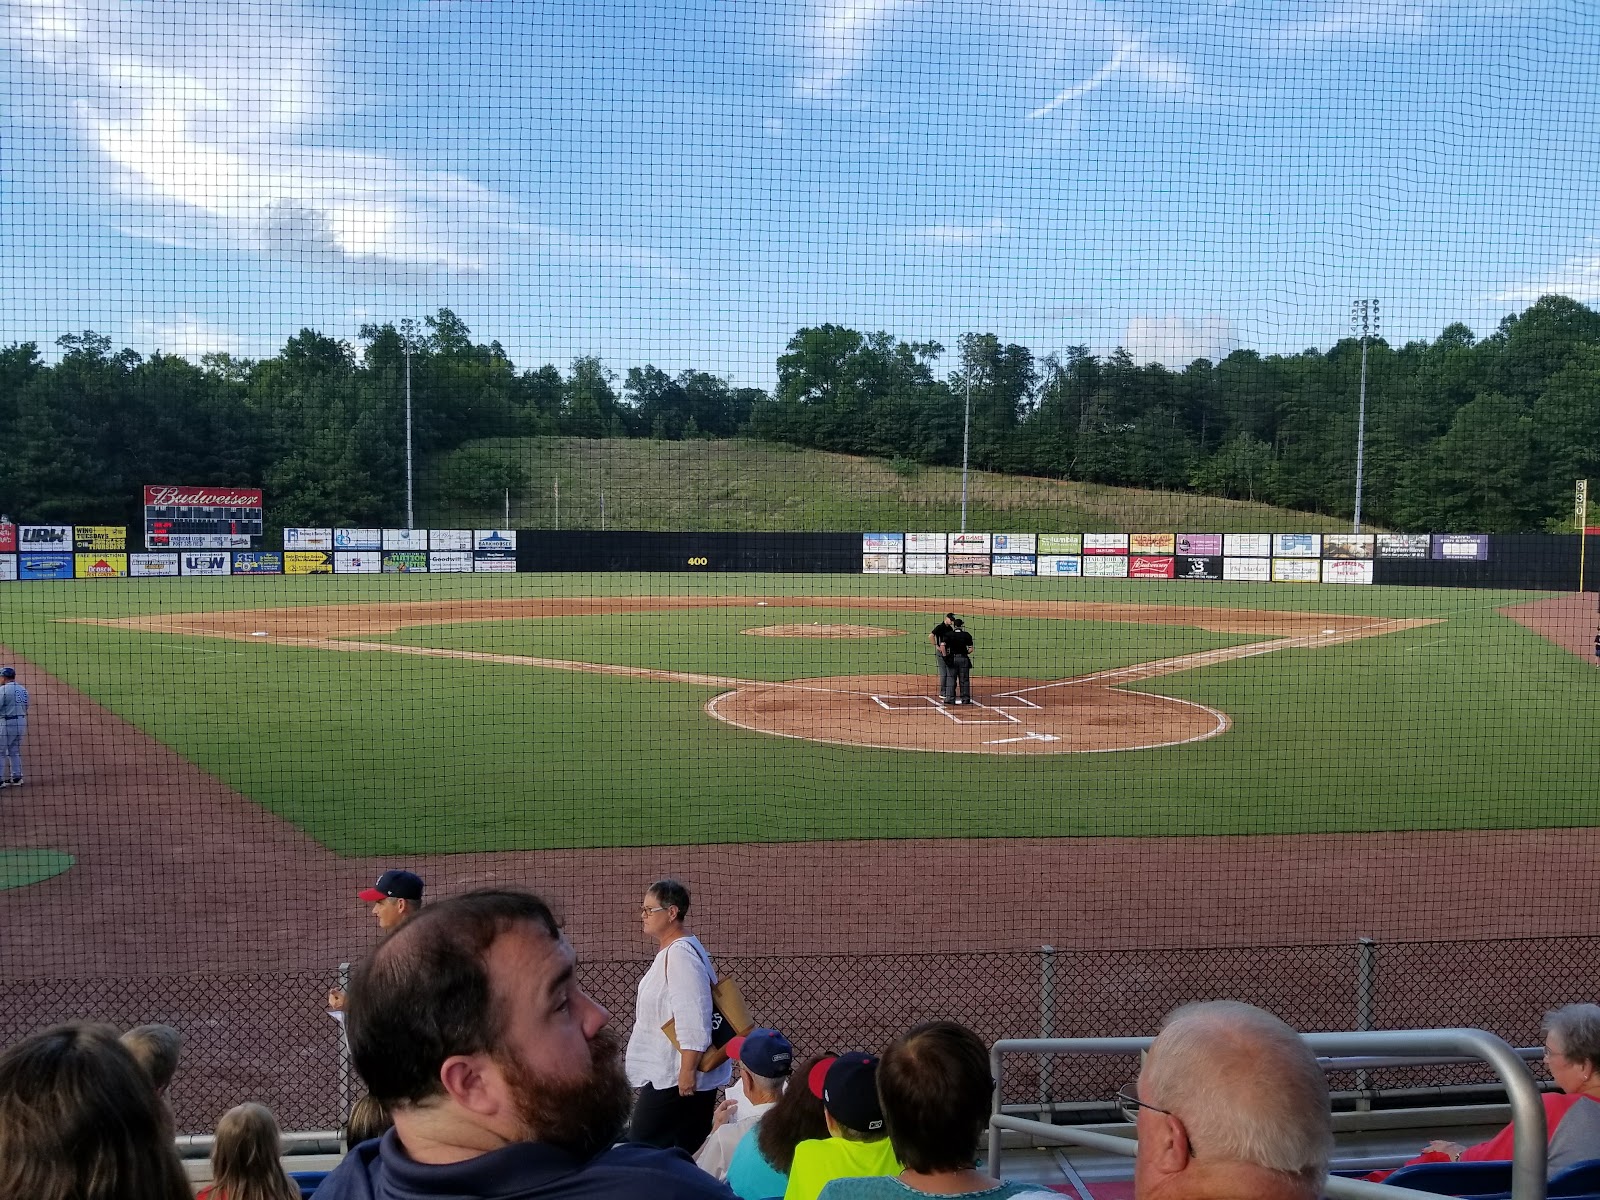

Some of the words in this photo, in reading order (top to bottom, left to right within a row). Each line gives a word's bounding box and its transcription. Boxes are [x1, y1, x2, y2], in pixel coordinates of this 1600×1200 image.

[150, 487, 258, 505] Budweiser
[185, 556, 225, 569] USW
[687, 557, 708, 565] 400
[1135, 560, 1168, 569] Budweiser
